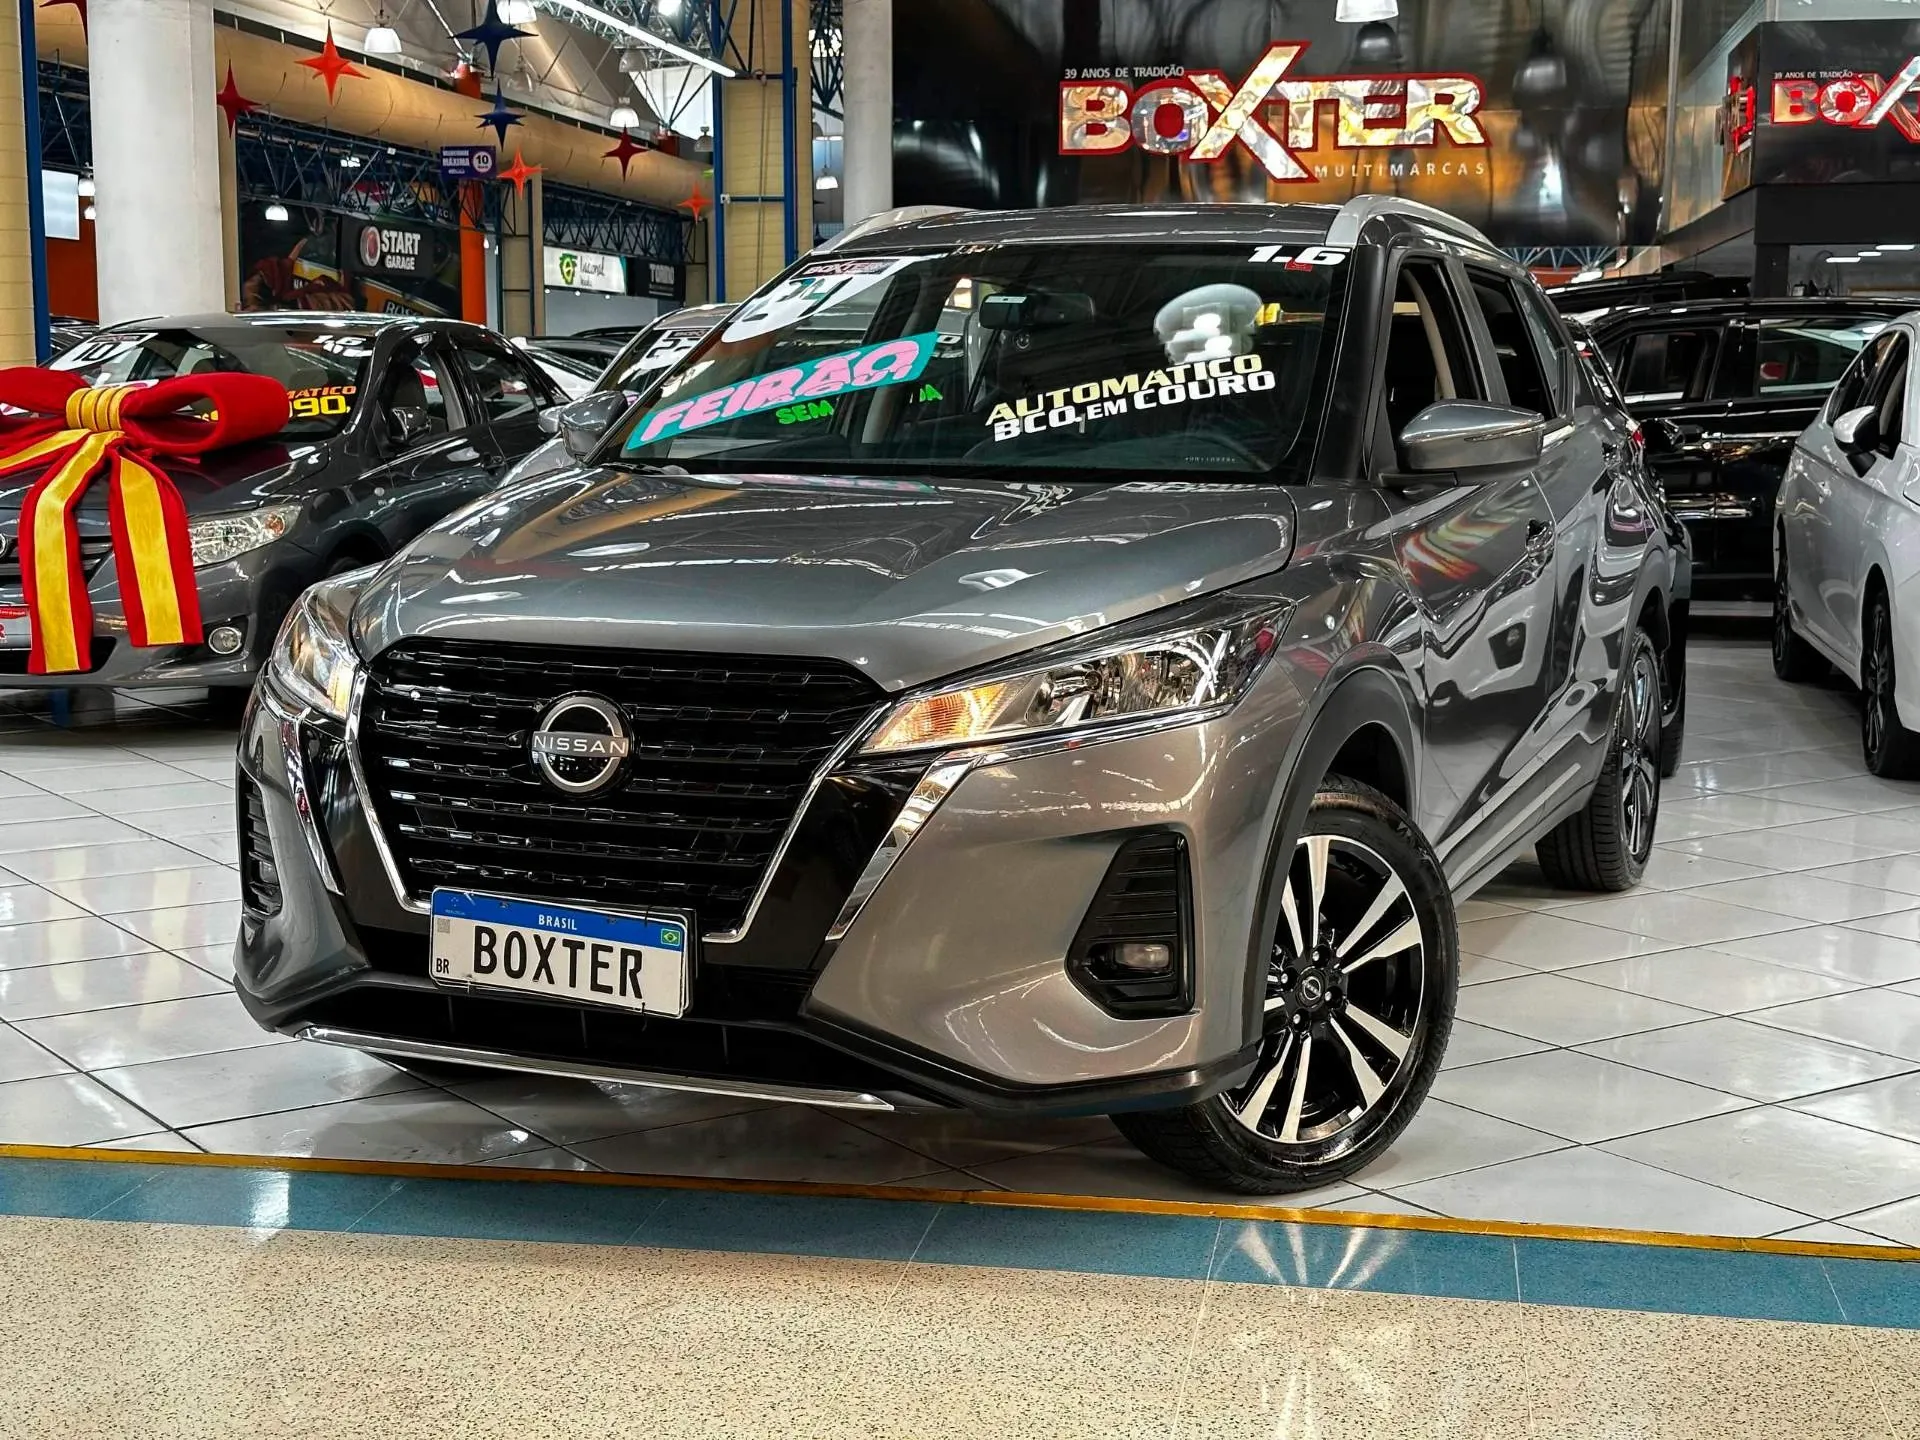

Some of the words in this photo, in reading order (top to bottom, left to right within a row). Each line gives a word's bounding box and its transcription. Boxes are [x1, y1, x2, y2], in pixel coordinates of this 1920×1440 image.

[1064, 68, 1077, 79] 39
[1081, 67, 1110, 79] ANOS
[1115, 67, 1128, 78] DE
[1133, 64, 1185, 79] TRADIÇÃO
[1820, 69, 1853, 79] TRADIÇÃO
[1770, 55, 1920, 143] BOX
[1059, 41, 1492, 183] BOXTER
[476, 154, 489, 165] 10
[1314, 162, 1485, 178] MULTIMARCAS
[381, 229, 421, 256] START
[384, 254, 416, 270] GARAGE
[1247, 245, 1351, 266] 1.6
[1086, 398, 1128, 420] EM
[1133, 370, 1276, 410] COURO
[775, 400, 834, 424] SEM
[533, 735, 626, 754] NISSAN
[538, 914, 578, 931] BRASIL
[435, 957, 450, 975] BR
[473, 925, 643, 1000] BOXTER
